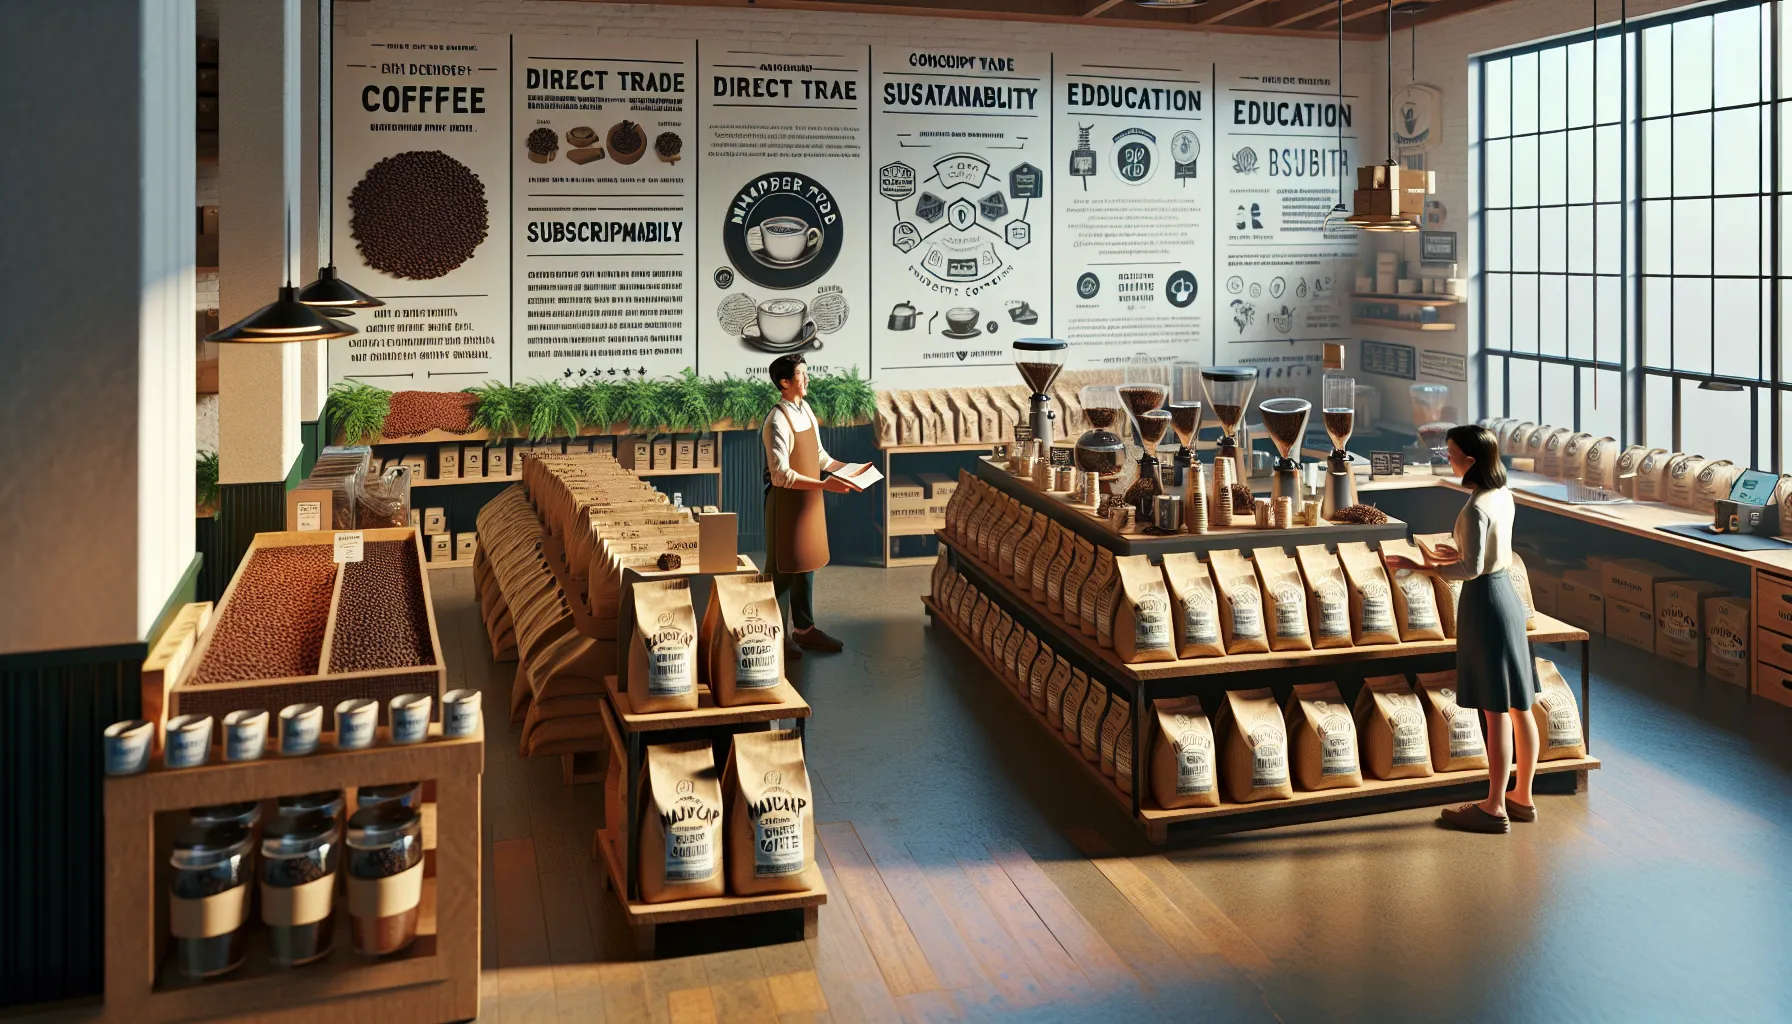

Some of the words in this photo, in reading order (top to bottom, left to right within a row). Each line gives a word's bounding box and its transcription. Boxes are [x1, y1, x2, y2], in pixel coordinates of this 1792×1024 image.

[527, 68, 608, 90] DIRECT
[617, 71, 685, 92] TRADE
[713, 75, 792, 98] DIRECT
[801, 79, 857, 100] TRAE
[361, 84, 486, 114] COFFFEE
[1067, 82, 1201, 111] EDDUCATION
[1233, 99, 1352, 128] EDUCATION
